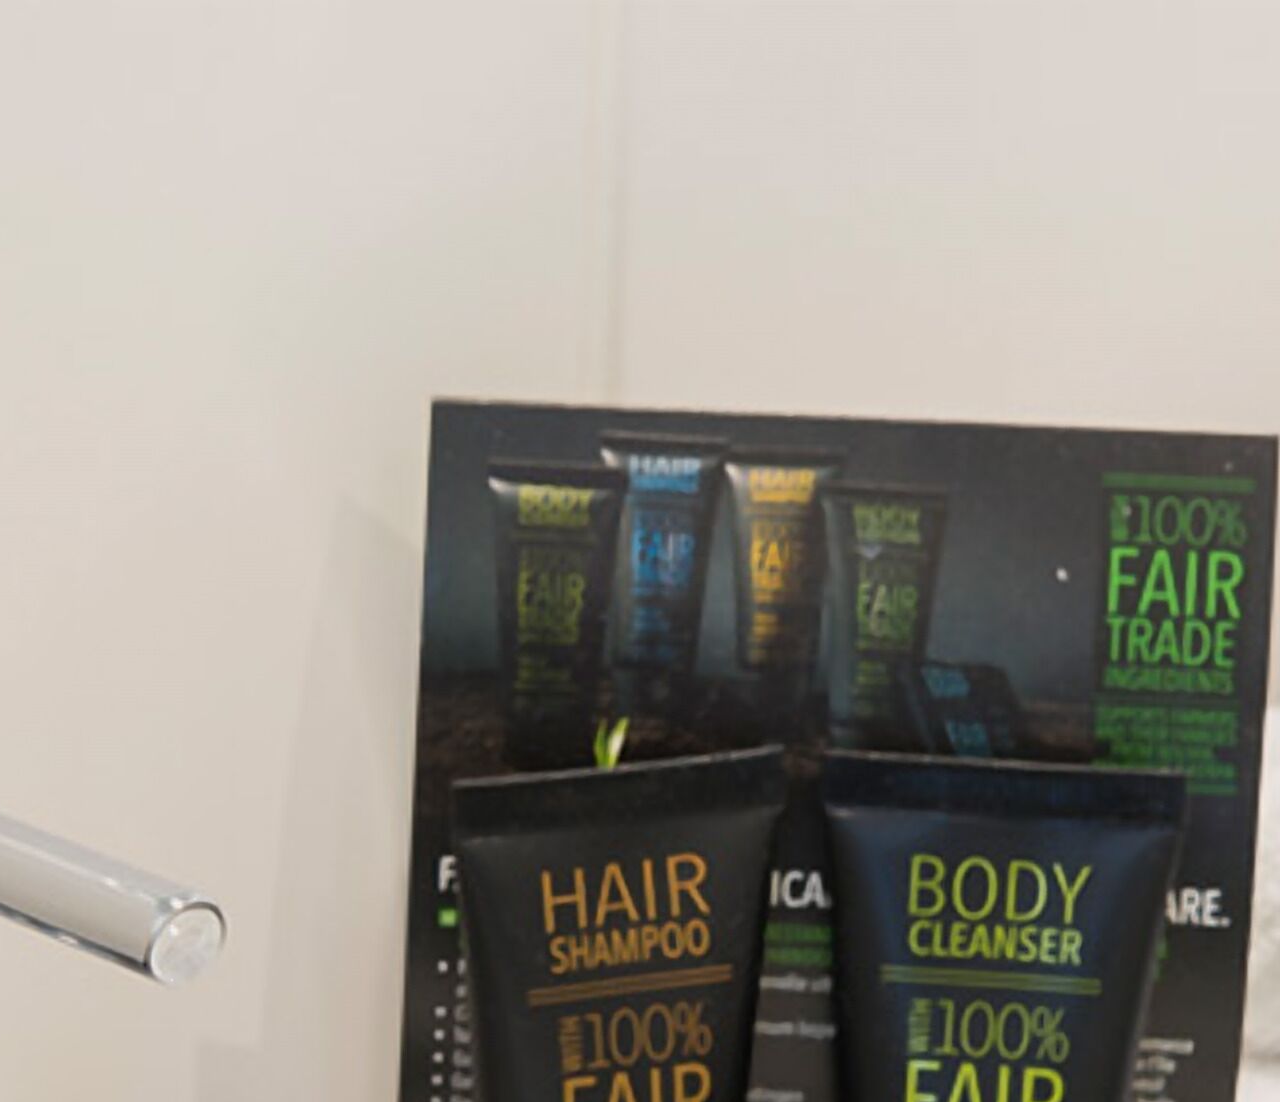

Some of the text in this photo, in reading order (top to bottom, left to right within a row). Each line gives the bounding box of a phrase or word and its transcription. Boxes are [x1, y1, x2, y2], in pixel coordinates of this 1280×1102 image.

[1134, 495, 1247, 547] 100%
[1107, 546, 1245, 619] FAIR
[1106, 616, 1237, 668] TRADE
[541, 852, 711, 933] HAIR
[908, 853, 1092, 925] BODY
[549, 920, 711, 974] SHAMPOO
[907, 920, 1082, 966] CLEANSER
[586, 1001, 712, 1070] 100%
[936, 999, 1070, 1062] 100%
